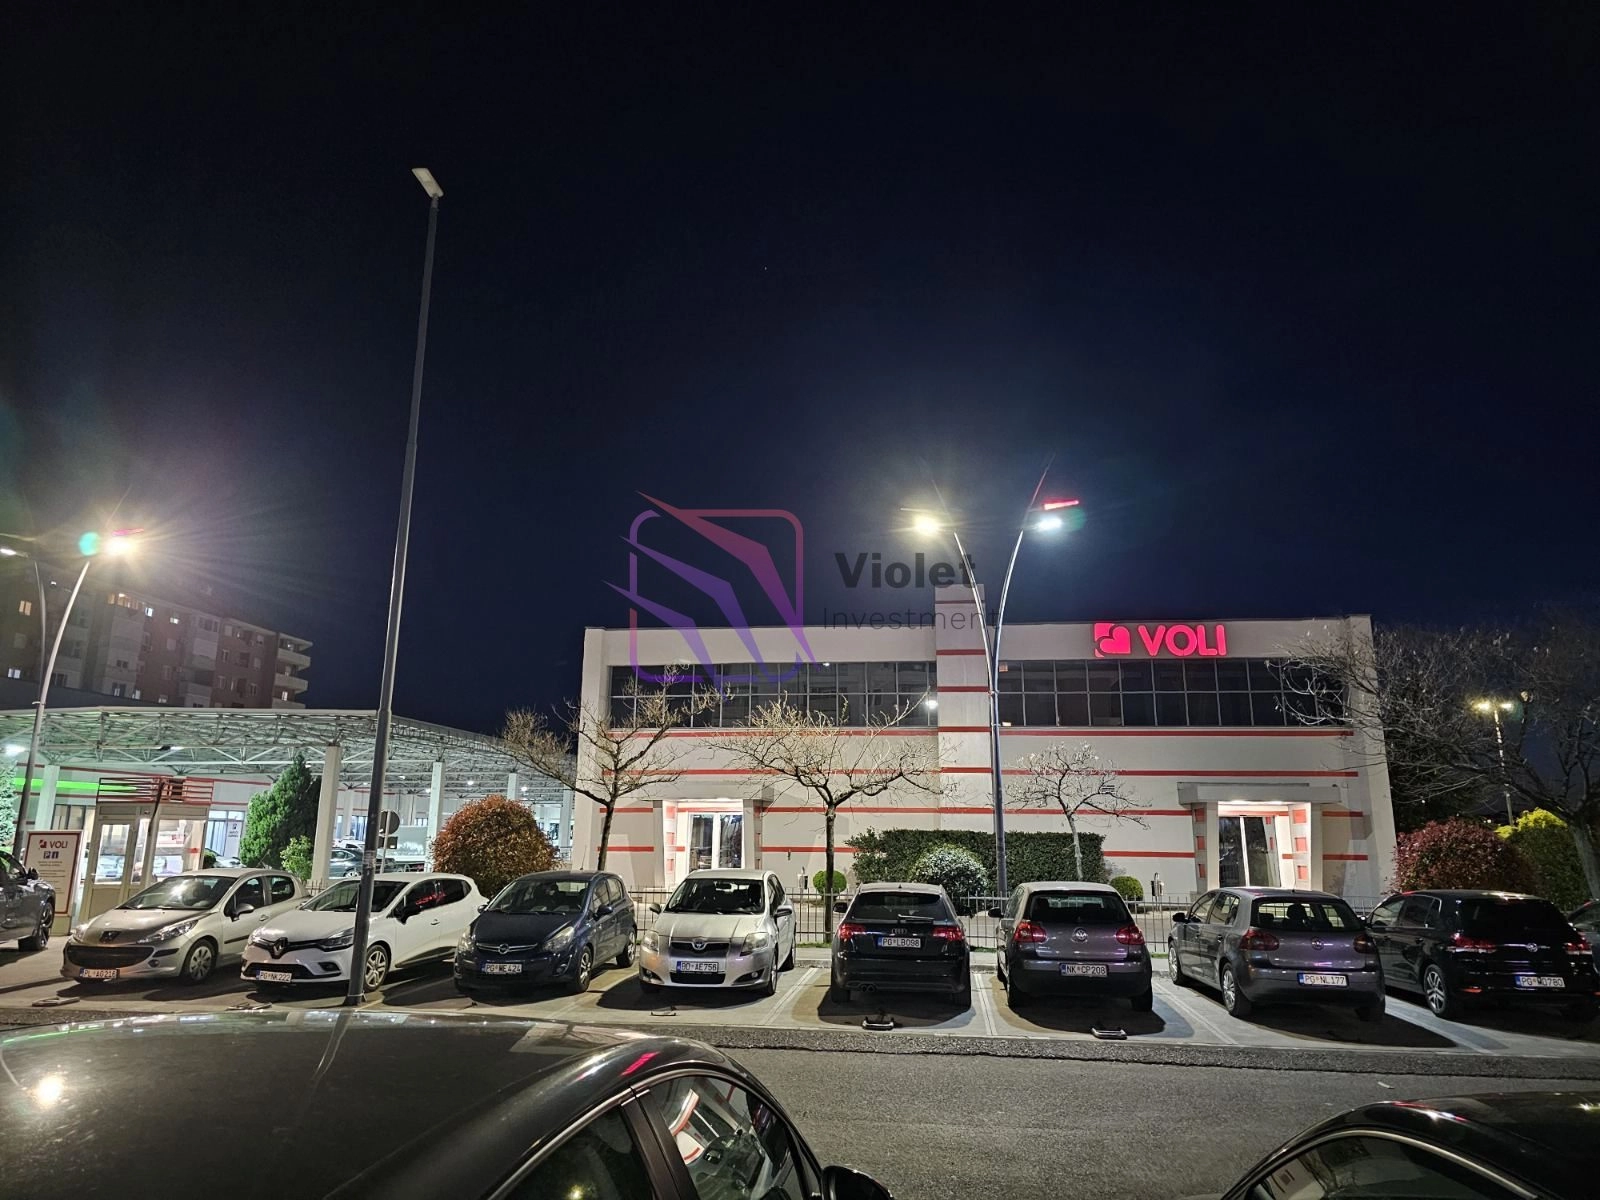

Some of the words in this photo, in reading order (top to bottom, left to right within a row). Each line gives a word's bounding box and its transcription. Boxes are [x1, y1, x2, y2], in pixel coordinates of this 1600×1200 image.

[1138, 625, 1227, 657] VOLI
[49, 841, 68, 849] VOLI
[882, 938, 892, 946] PG
[1066, 965, 1076, 974] NK
[1080, 966, 1106, 975] CP208
[1305, 975, 1316, 984] PG
[1521, 977, 1533, 986] PG
